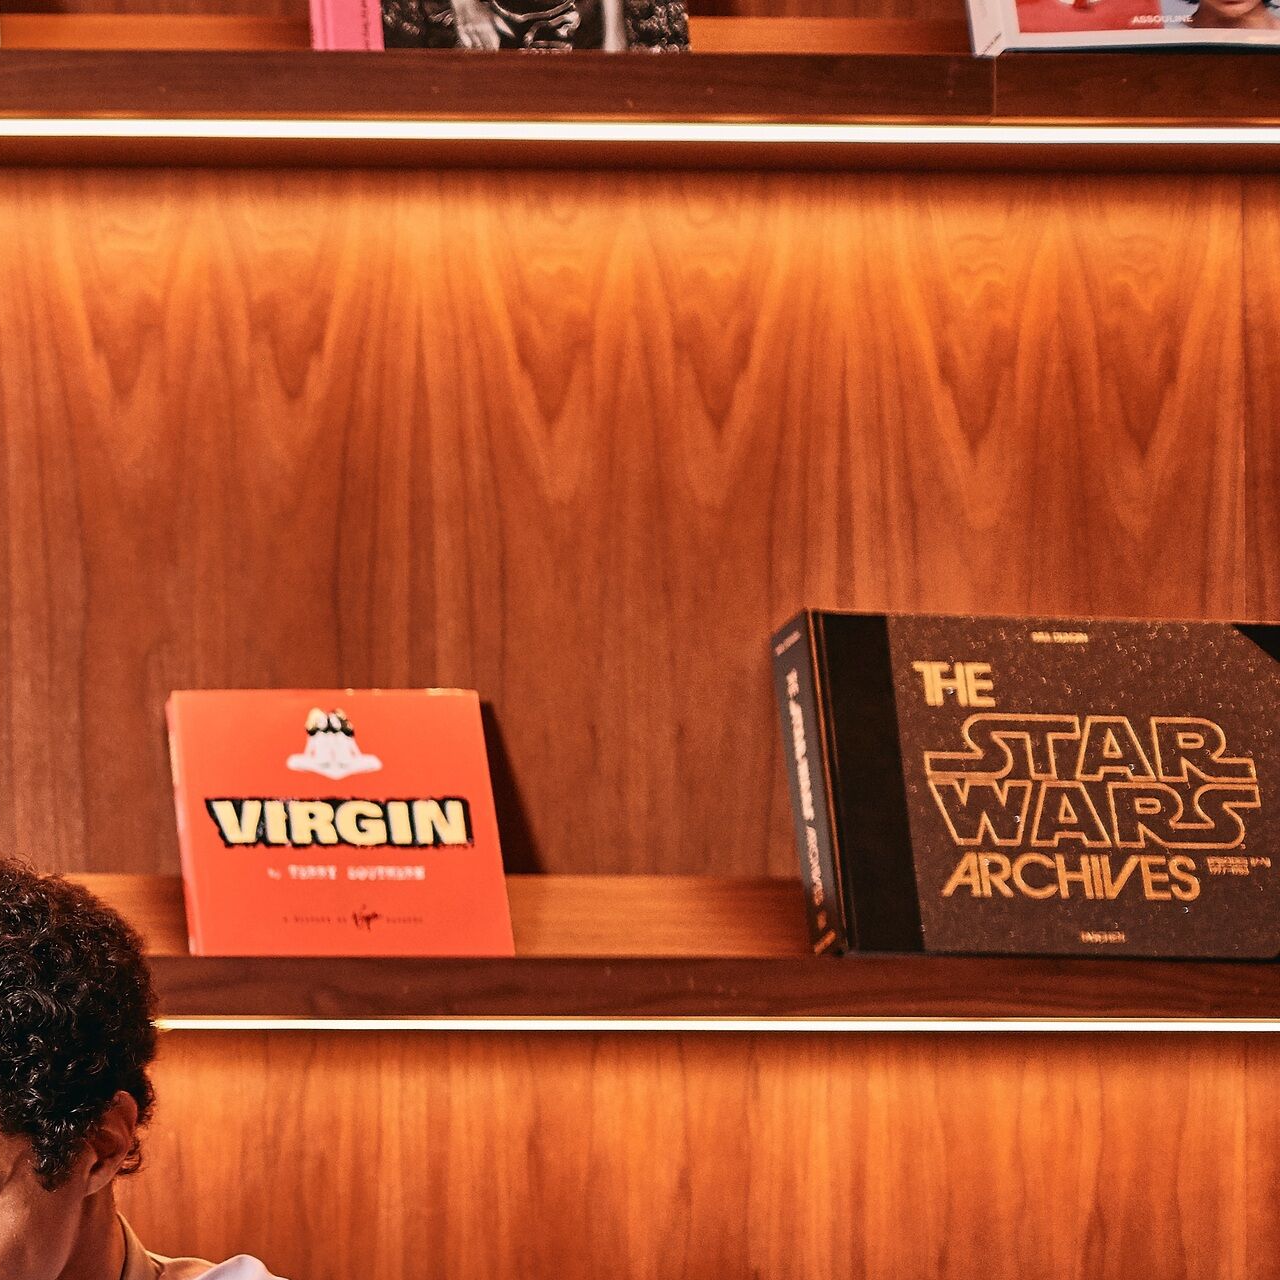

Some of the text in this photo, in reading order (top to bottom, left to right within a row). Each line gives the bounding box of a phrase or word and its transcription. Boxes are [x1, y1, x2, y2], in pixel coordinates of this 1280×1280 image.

[1131, 14, 1194, 24] ASSOULINE
[913, 660, 997, 708] THE
[923, 713, 1258, 782] STAR
[208, 798, 473, 849] VIRGIN
[927, 779, 1262, 850] WARS
[942, 851, 1202, 902] ARCHIVES
